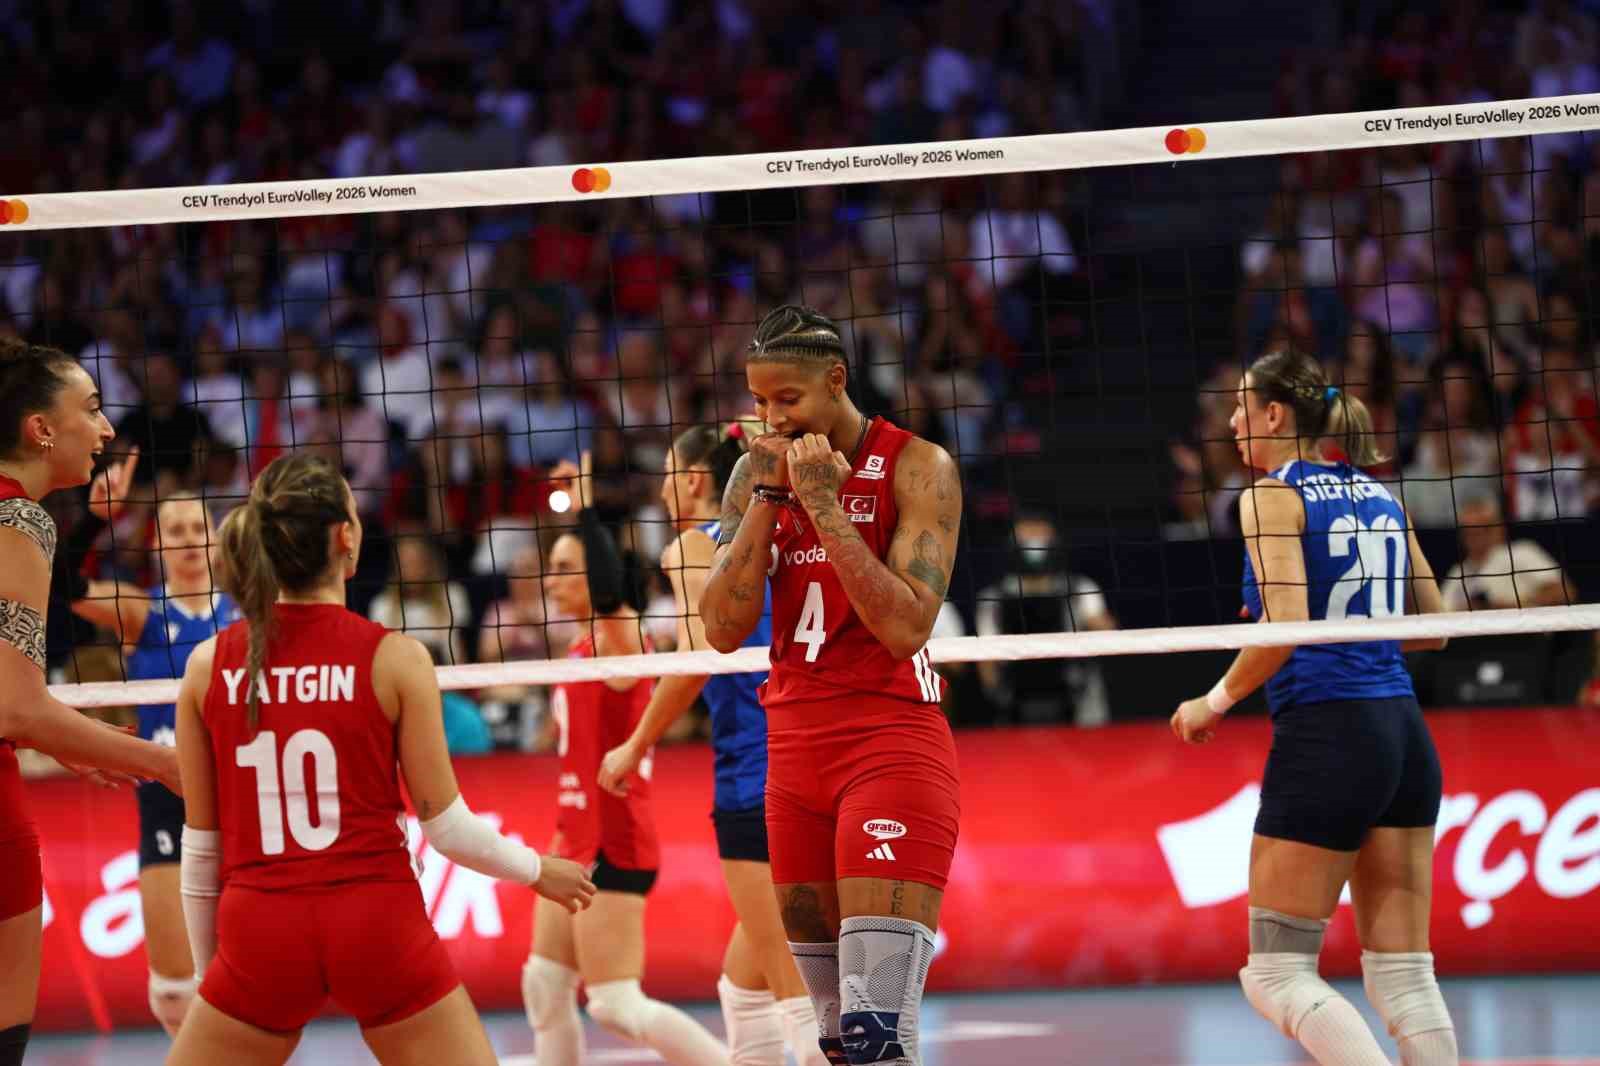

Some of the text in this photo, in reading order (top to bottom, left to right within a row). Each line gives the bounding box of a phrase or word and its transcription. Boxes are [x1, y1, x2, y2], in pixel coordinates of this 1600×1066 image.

[1364, 103, 1600, 132] CEV Trendyol EuroVolley 2026 Wom
[766, 149, 1004, 173] CEV Trendyol EuroVolley 2026 Women
[182, 185, 417, 208] CEV Trendyol EuroVolley 2026 Women
[869, 458, 880, 468] S
[784, 544, 832, 566] voda
[1326, 513, 1406, 620] 20
[793, 581, 827, 662] 4
[221, 664, 356, 705] YATGIN
[235, 728, 342, 856] 10
[867, 822, 903, 833] gratis
[1434, 787, 1600, 930] rçe
